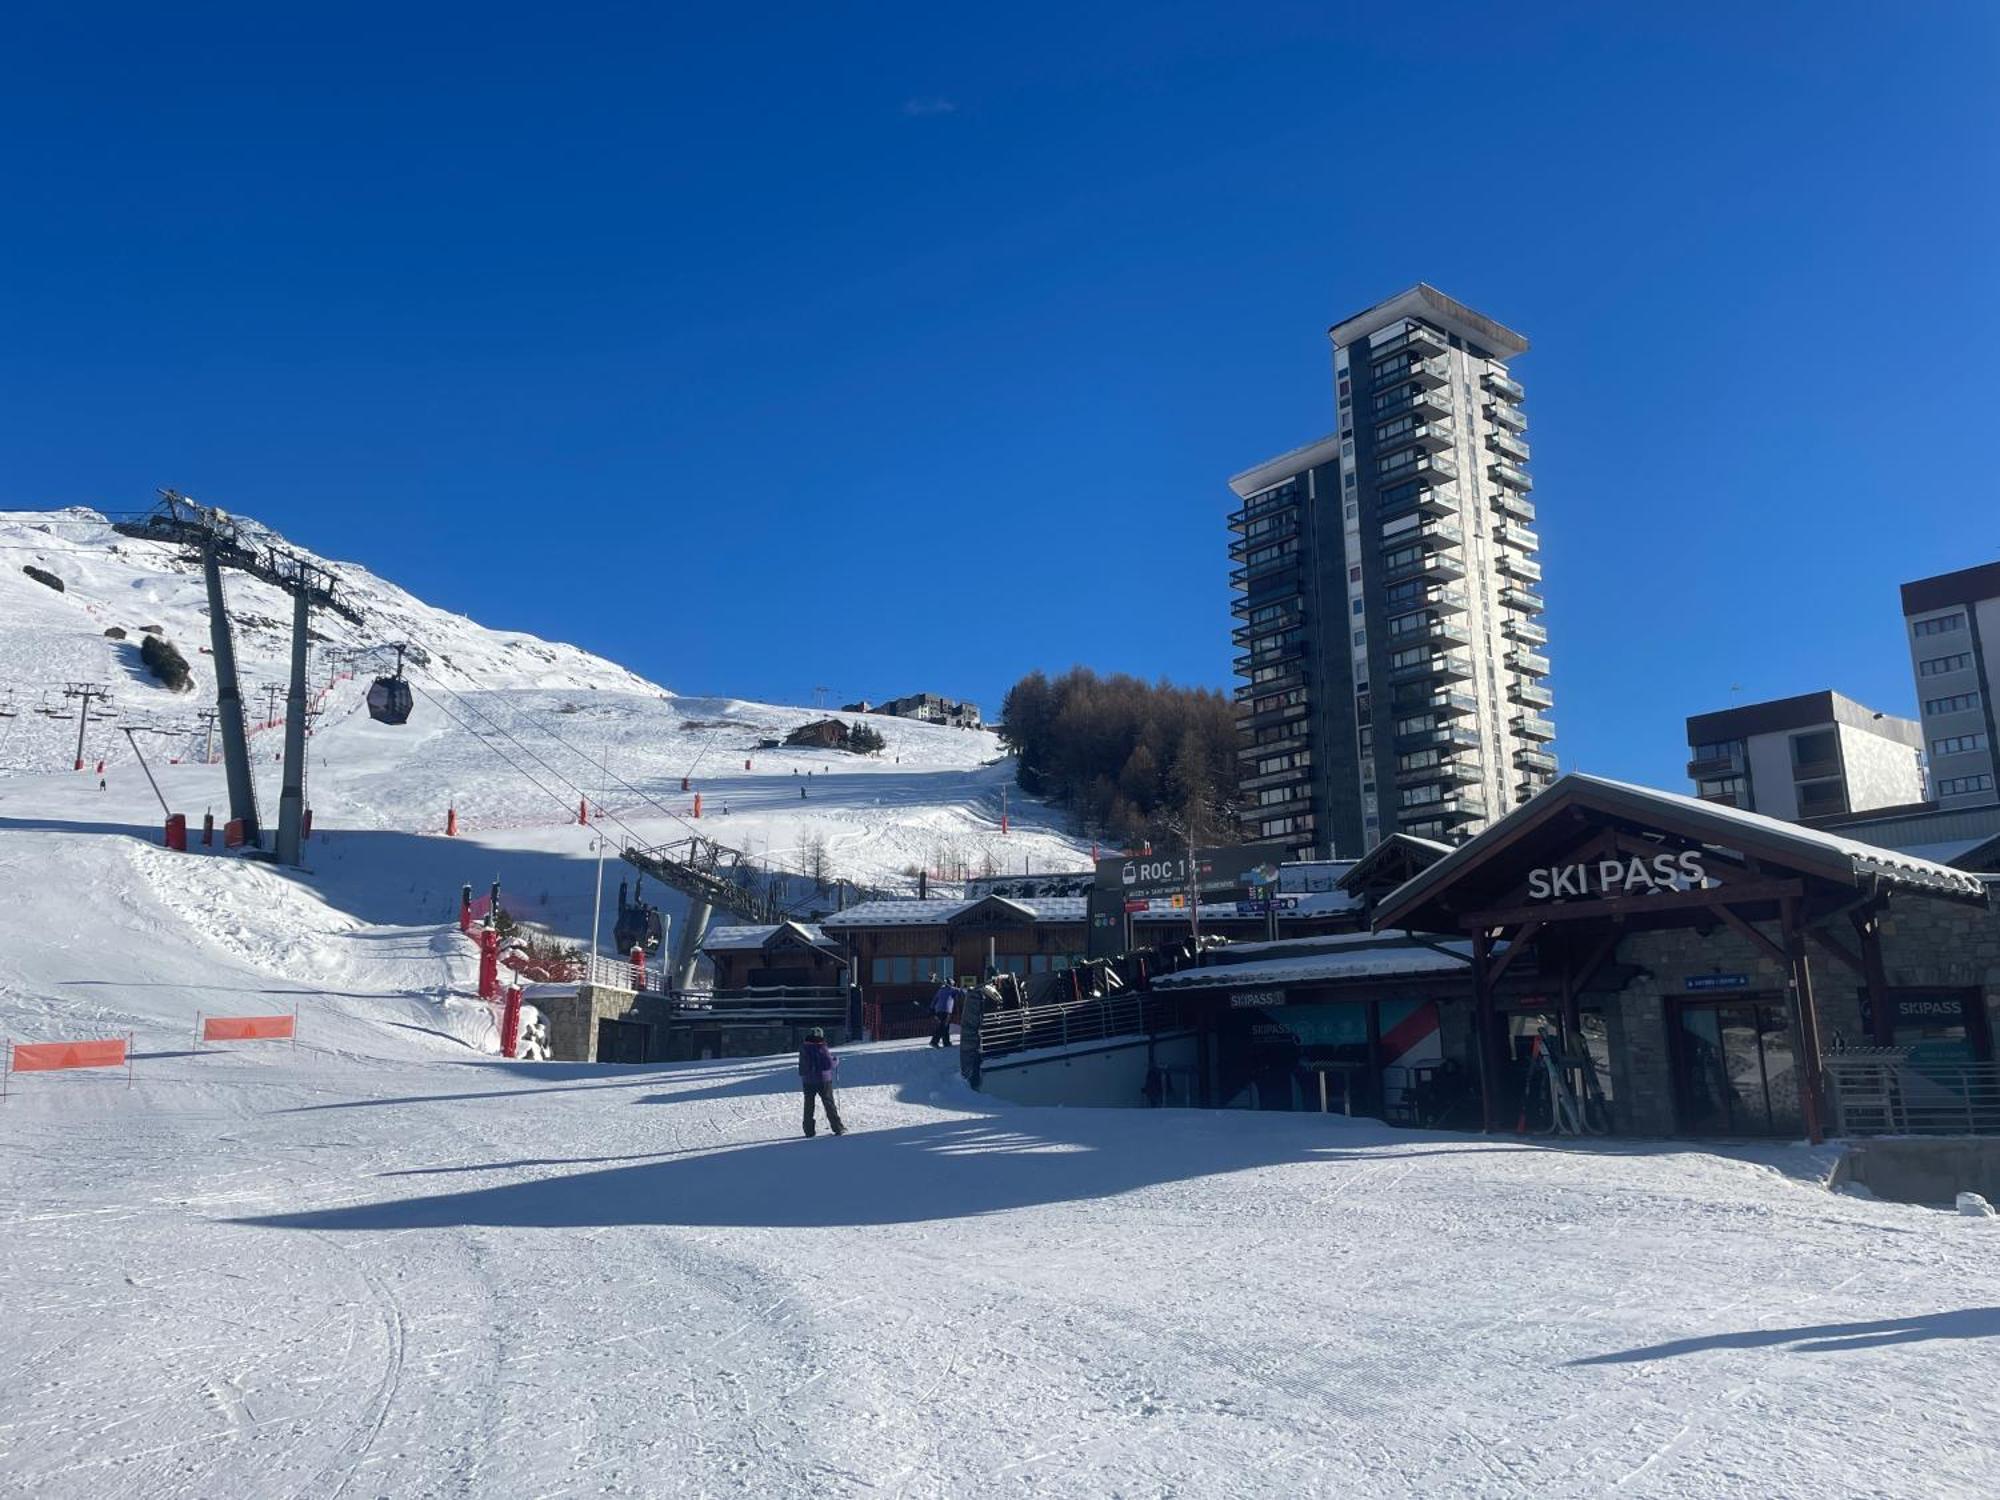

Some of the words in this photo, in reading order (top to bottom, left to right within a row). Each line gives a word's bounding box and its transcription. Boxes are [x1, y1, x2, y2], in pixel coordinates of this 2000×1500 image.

[1141, 861, 1172, 881] ROC
[1179, 860, 1185, 876] 1
[1528, 863, 1587, 899] SKI
[1599, 850, 1705, 892] PASS
[1231, 993, 1273, 1008] SKIPASS
[1899, 1001, 1962, 1015] SKIPASS
